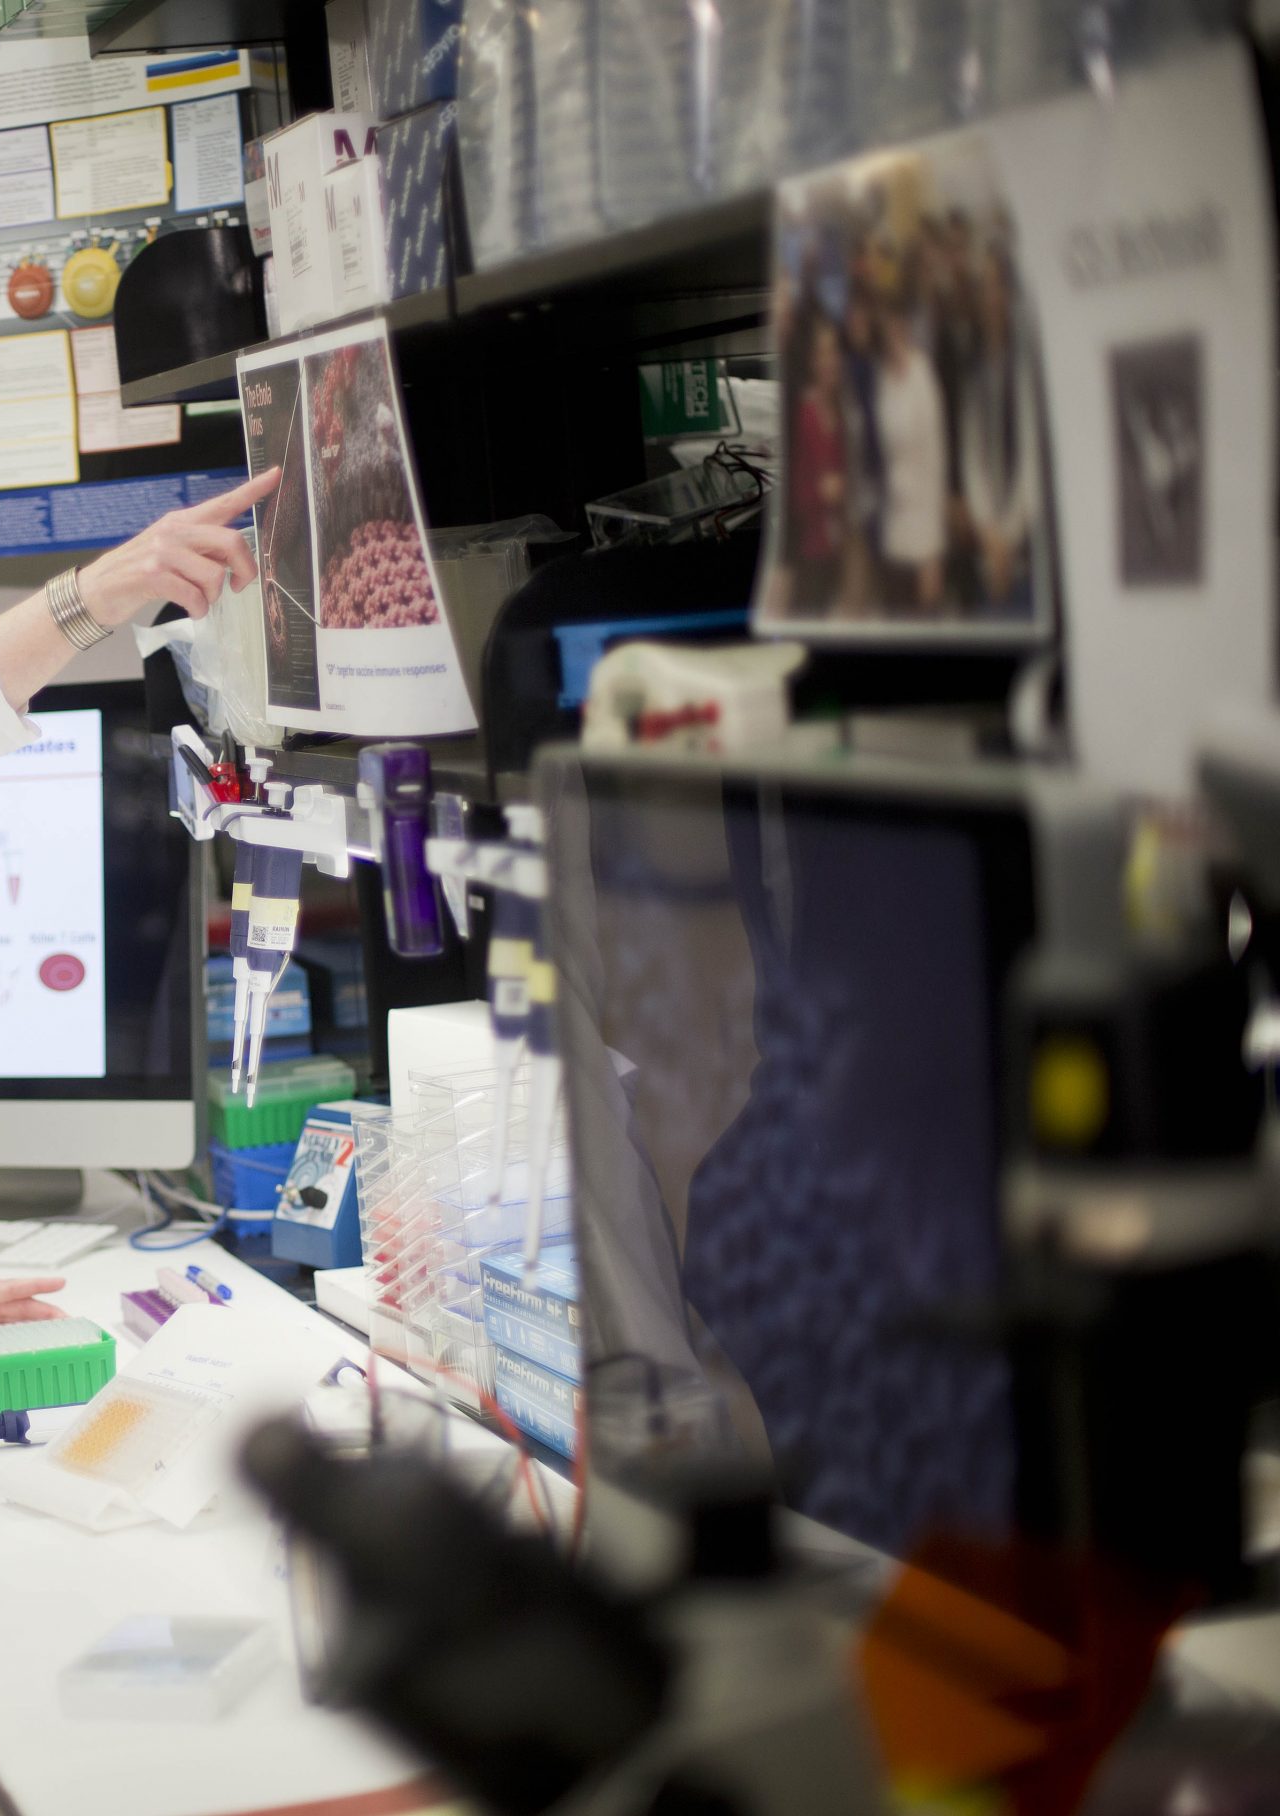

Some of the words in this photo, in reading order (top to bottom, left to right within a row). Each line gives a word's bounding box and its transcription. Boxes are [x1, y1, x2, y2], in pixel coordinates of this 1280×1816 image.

[245, 385, 257, 409] The
[256, 380, 273, 407] Ebola
[248, 413, 264, 437] Virus
[402, 663, 447, 679] responses
[336, 1138, 354, 1167] 2
